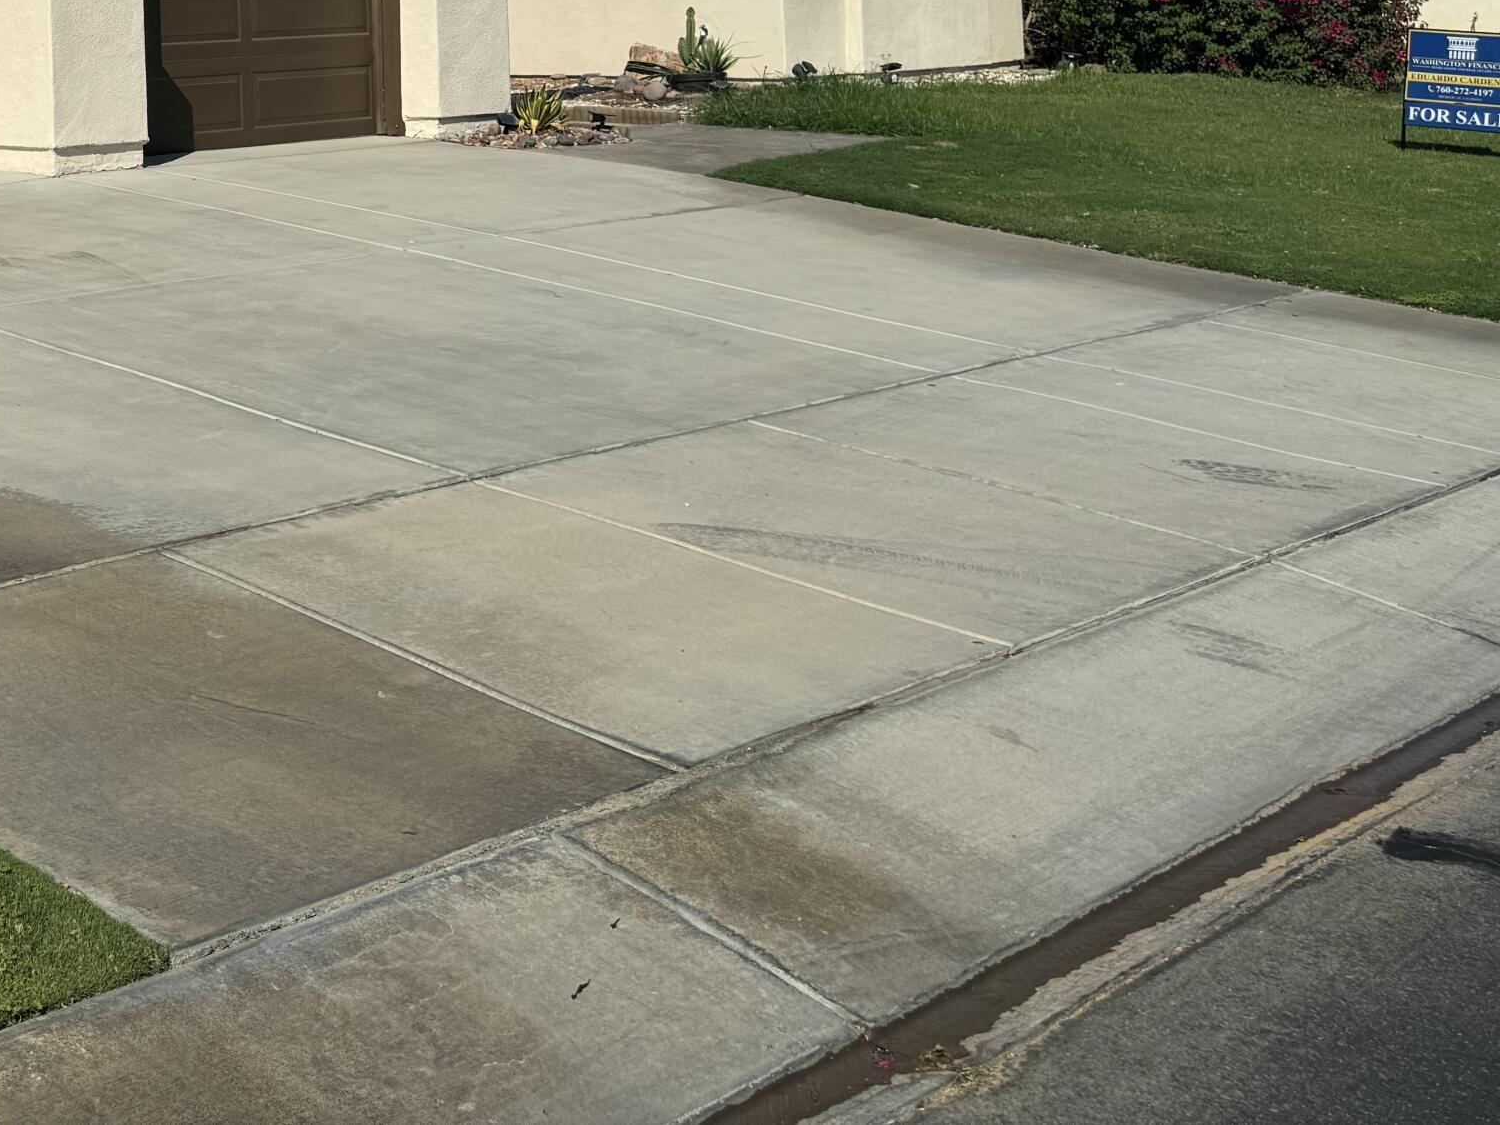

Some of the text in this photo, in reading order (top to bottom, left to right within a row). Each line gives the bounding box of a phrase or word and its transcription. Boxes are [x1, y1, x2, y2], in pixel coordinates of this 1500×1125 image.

[1412, 58, 1466, 68] WASHINGTON
[1411, 73, 1457, 83] EDUARDO
[1435, 85, 1494, 97] 760-272-4197
[1408, 106, 1500, 127] FOR SAL
